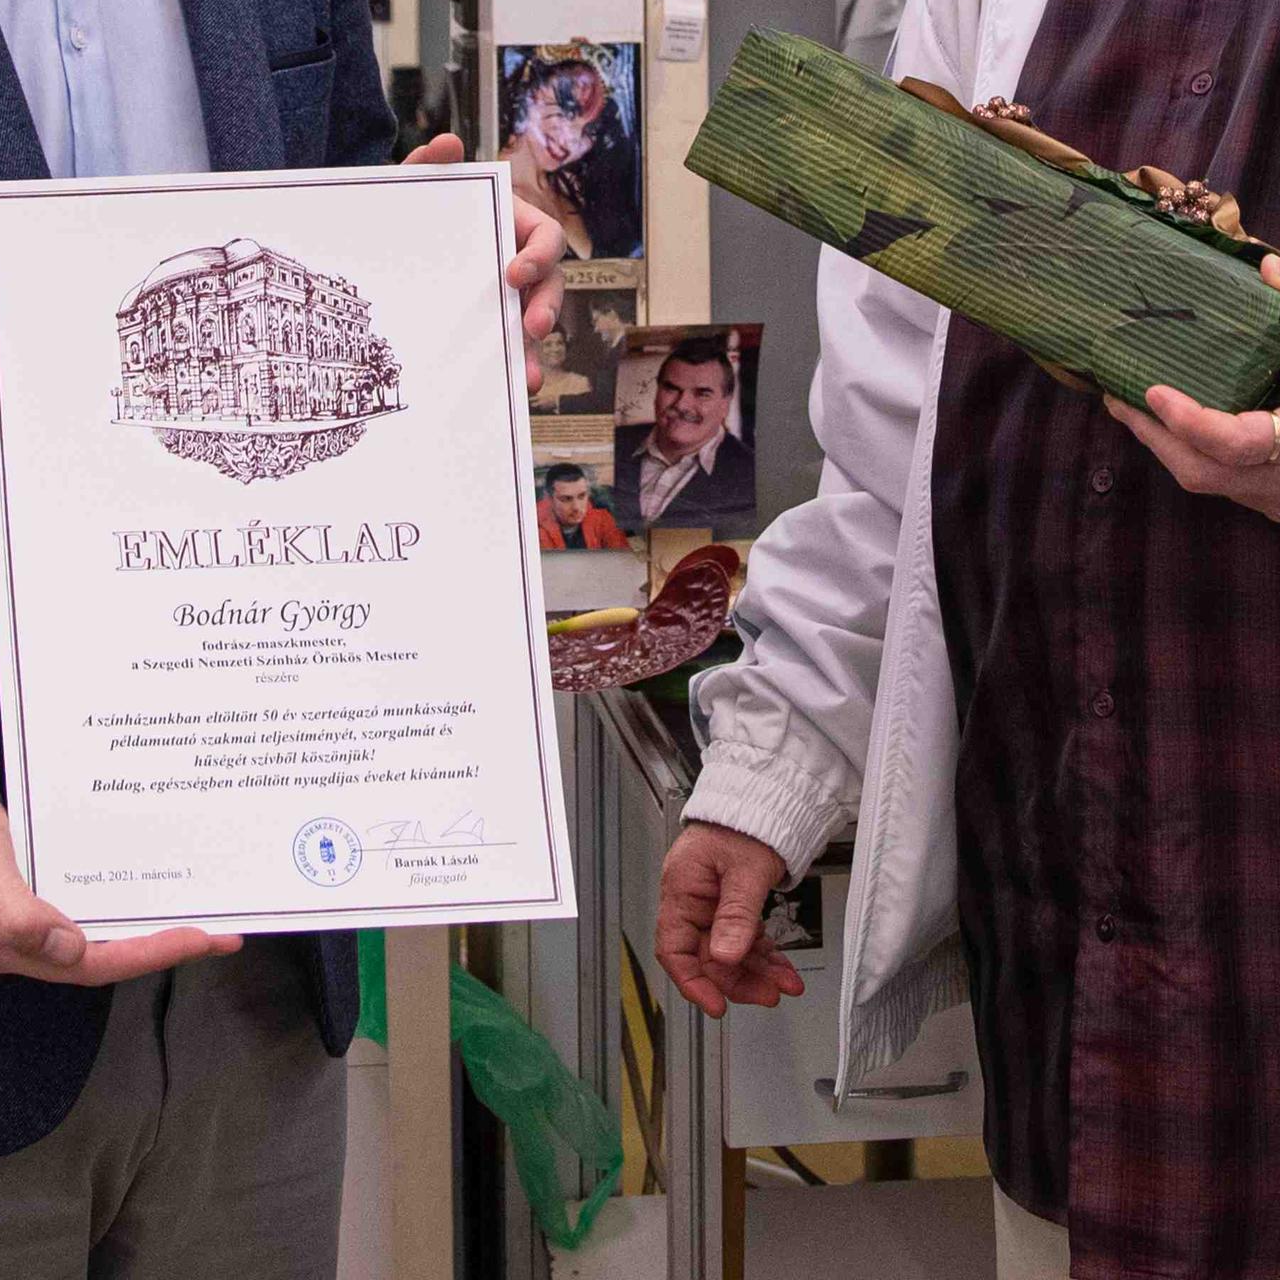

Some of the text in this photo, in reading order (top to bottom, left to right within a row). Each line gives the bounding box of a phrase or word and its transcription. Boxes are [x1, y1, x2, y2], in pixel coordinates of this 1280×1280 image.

[112, 519, 421, 572] EMLÉKLAP
[173, 599, 371, 632] Bodnár György
[202, 636, 347, 652] fodrász-maszkmester,
[131, 649, 419, 673] a Szegedi Nemzeti Színház Örökös Mestere
[255, 671, 300, 684] részére
[81, 700, 477, 728] A színházunkban eltöltött 50 év szerteágazó munkásságát,
[110, 723, 453, 751] példamutató szakmai teljesítményét, szorgalmát és
[194, 748, 376, 770] hűségét szívből köszönjük!
[92, 764, 480, 795] Boldog, egészségben eltöltött nyugdíjas éveket kívánunk!
[303, 822, 344, 839] NEMZETI
[394, 853, 479, 869] Barnák László
[63, 868, 195, 886] Szeged, 2021. március 3.
[408, 871, 468, 887] főigazgató
